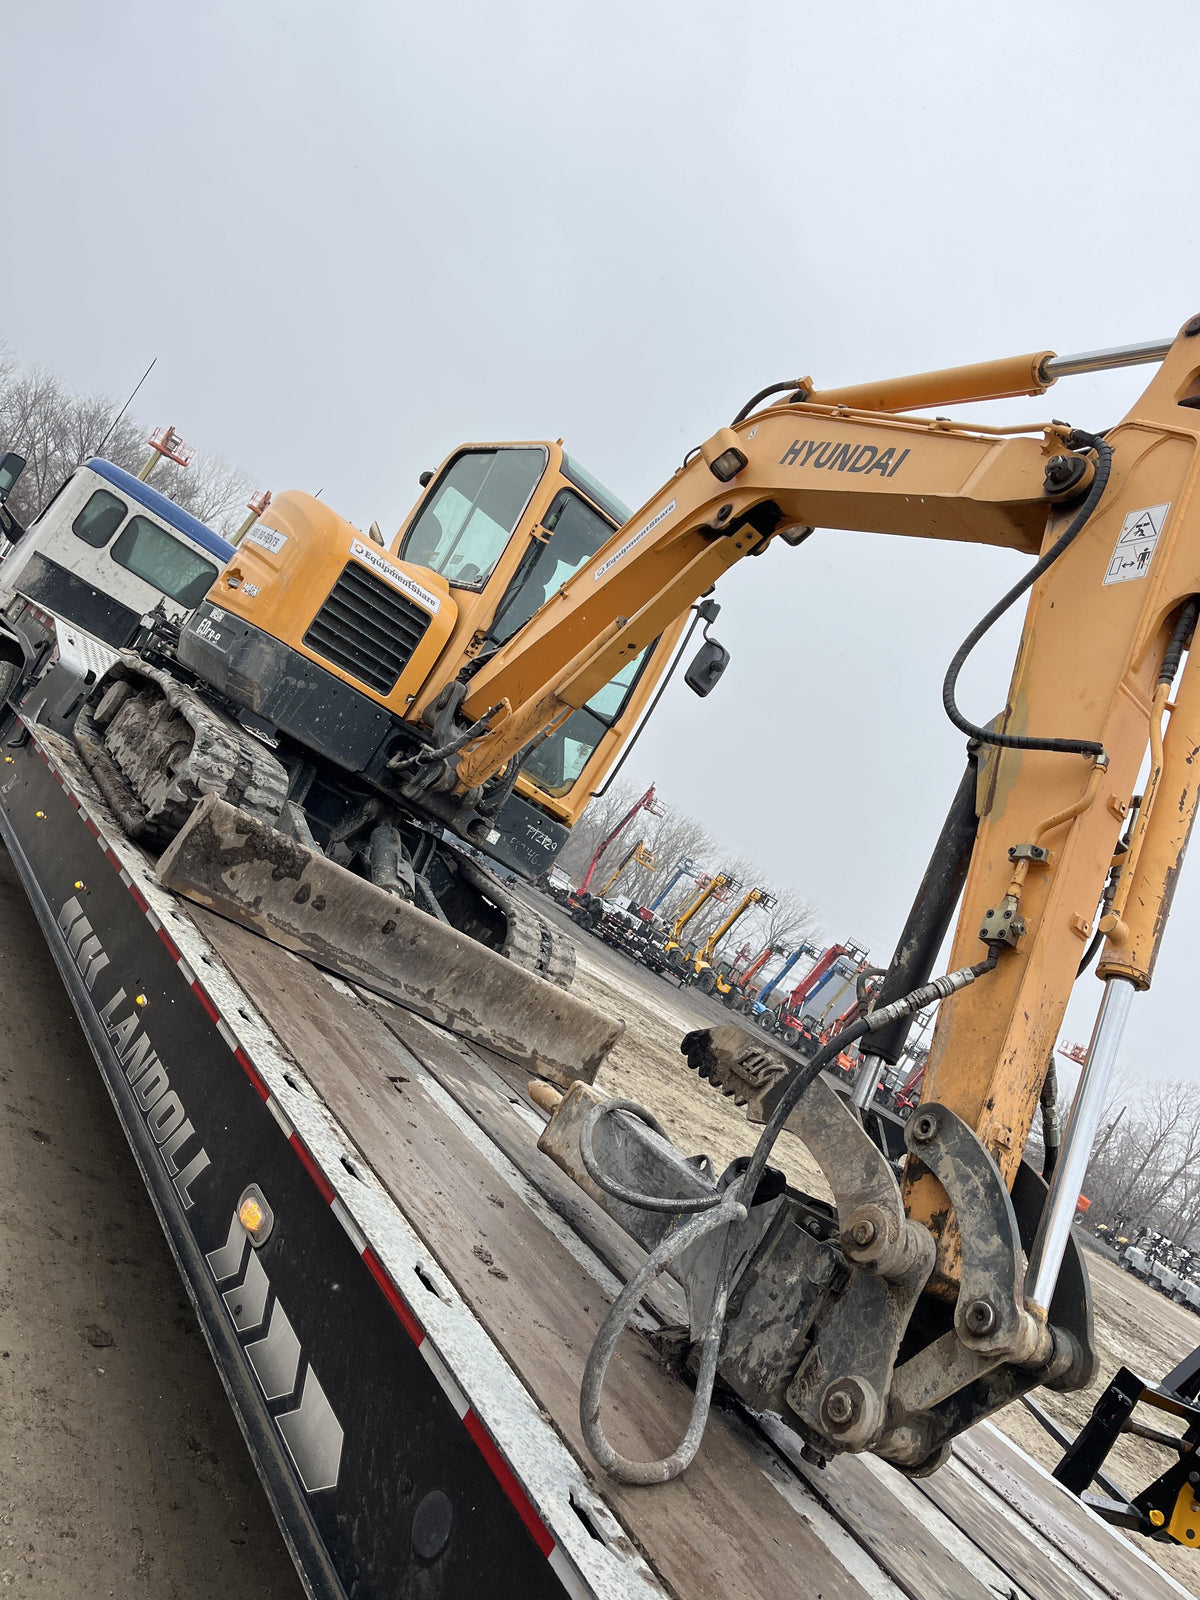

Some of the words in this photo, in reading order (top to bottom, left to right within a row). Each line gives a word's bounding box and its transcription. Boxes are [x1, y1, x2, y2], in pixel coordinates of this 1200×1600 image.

[779, 439, 911, 478] HYUNDAI
[605, 504, 674, 569] EquipmentShare
[364, 550, 436, 607] EquipmentShare
[99, 987, 211, 1210] LANDOLL
